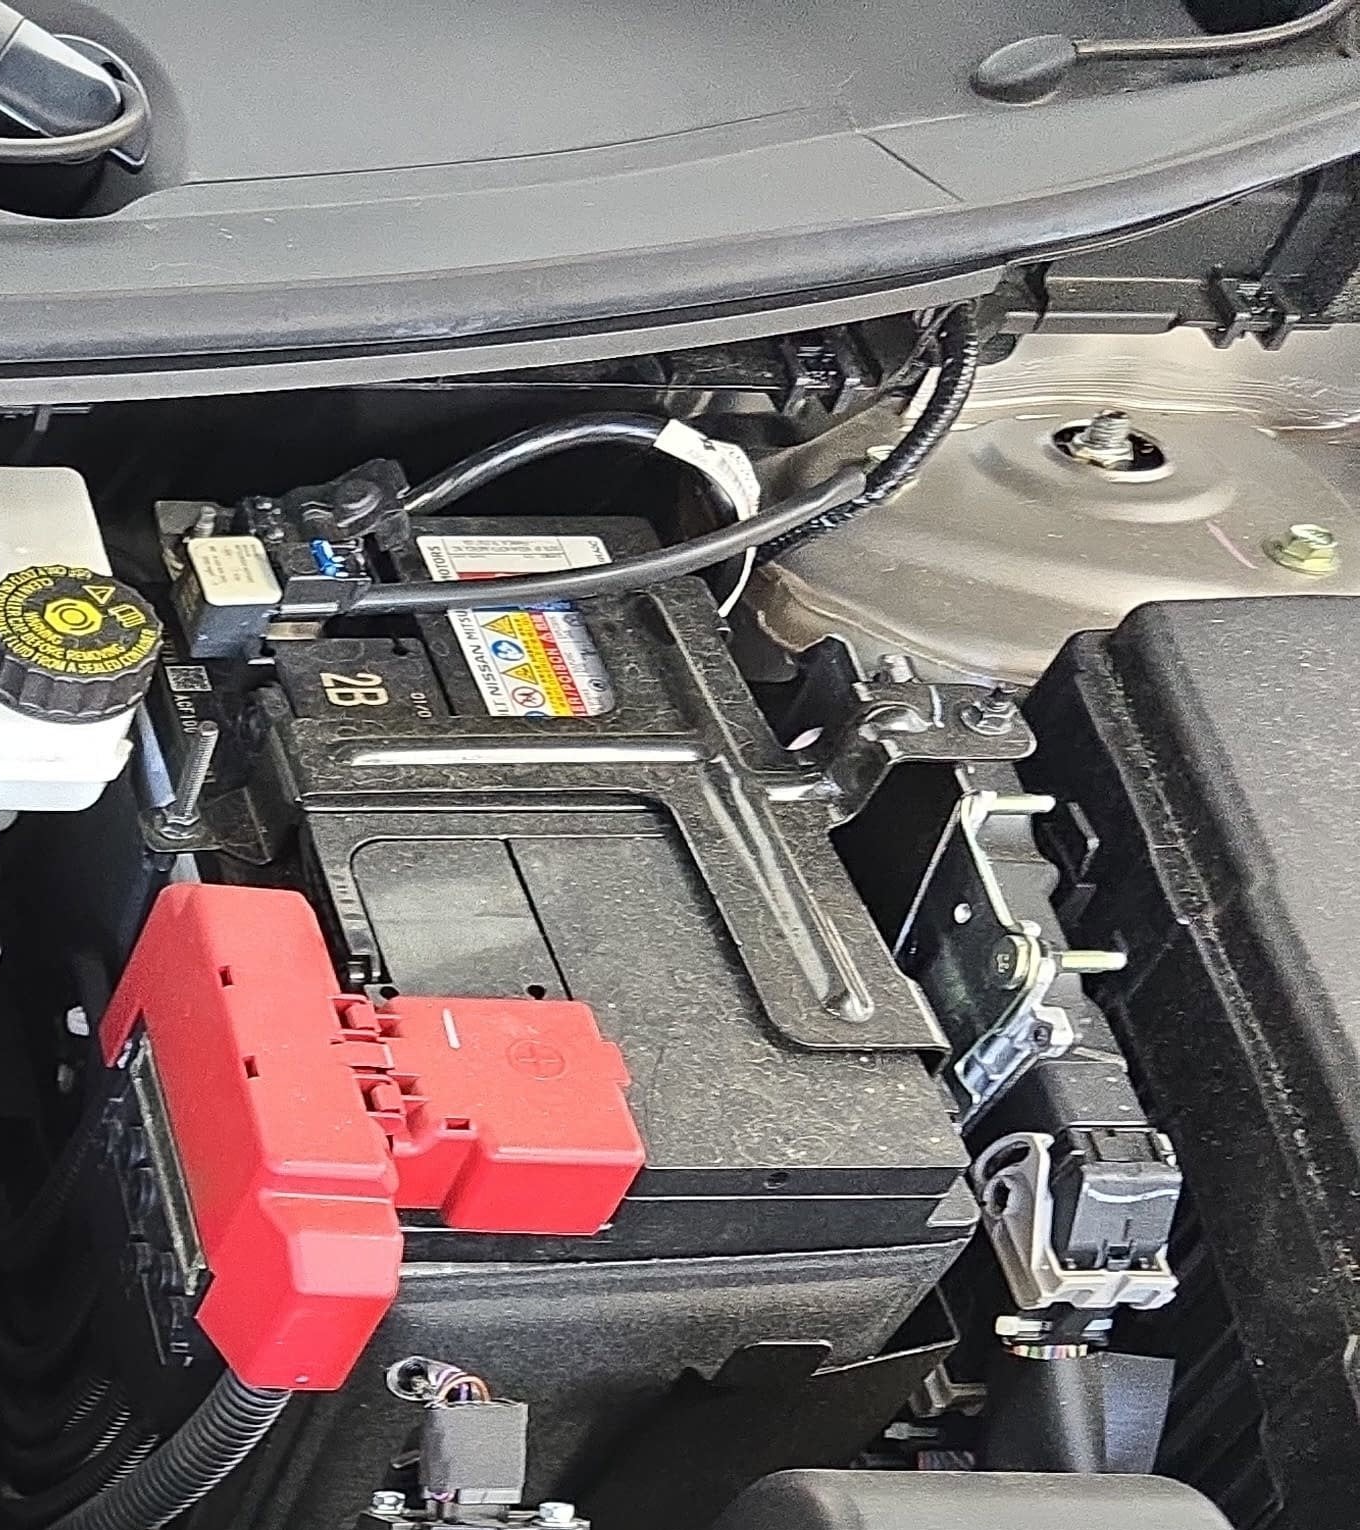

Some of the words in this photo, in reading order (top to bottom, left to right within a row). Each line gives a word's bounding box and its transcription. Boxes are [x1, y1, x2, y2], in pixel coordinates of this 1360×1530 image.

[7, 617, 29, 634] CAP
[19, 633, 65, 659] BEFORE
[66, 643, 126, 661] REMOVING
[28, 611, 63, 645] WARNING
[33, 653, 67, 672] FROM
[66, 661, 77, 673] A
[77, 658, 124, 673] SEALED
[121, 628, 157, 665] CONTAINER
[468, 645, 504, 696] NISSAN
[320, 672, 389, 707] 2B
